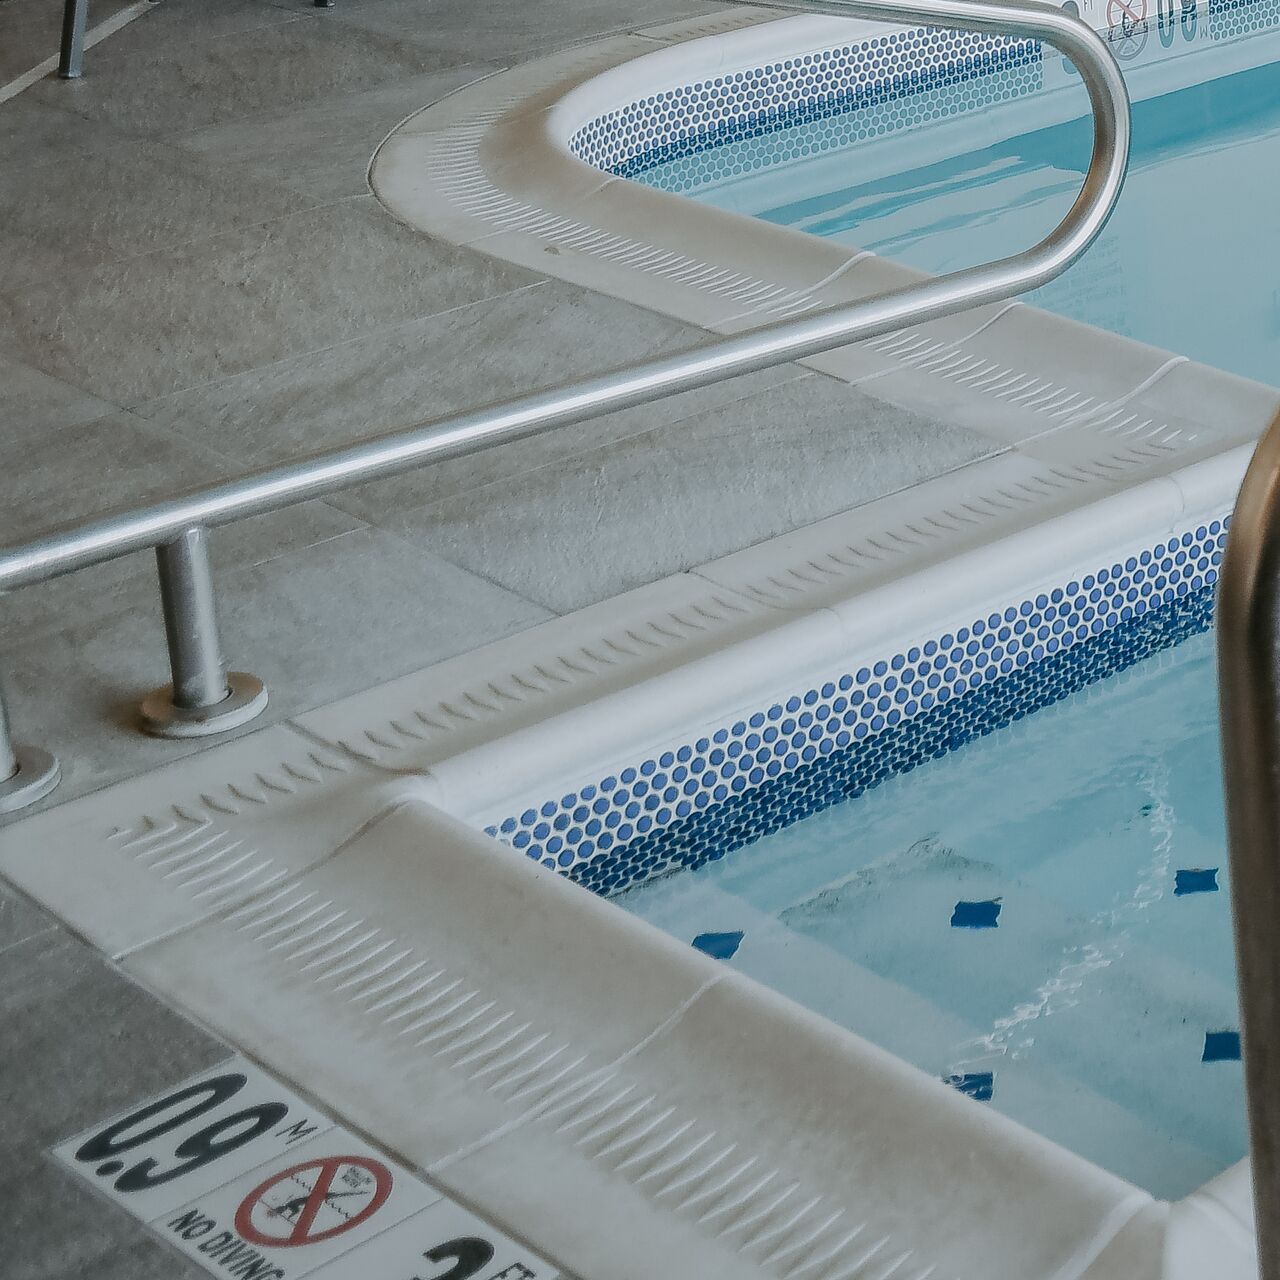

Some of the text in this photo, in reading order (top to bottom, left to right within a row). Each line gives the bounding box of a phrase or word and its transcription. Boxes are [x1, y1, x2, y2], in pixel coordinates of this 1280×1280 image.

[75, 1073, 319, 1192] 0.9 M
[167, 1208, 217, 1241] NO
